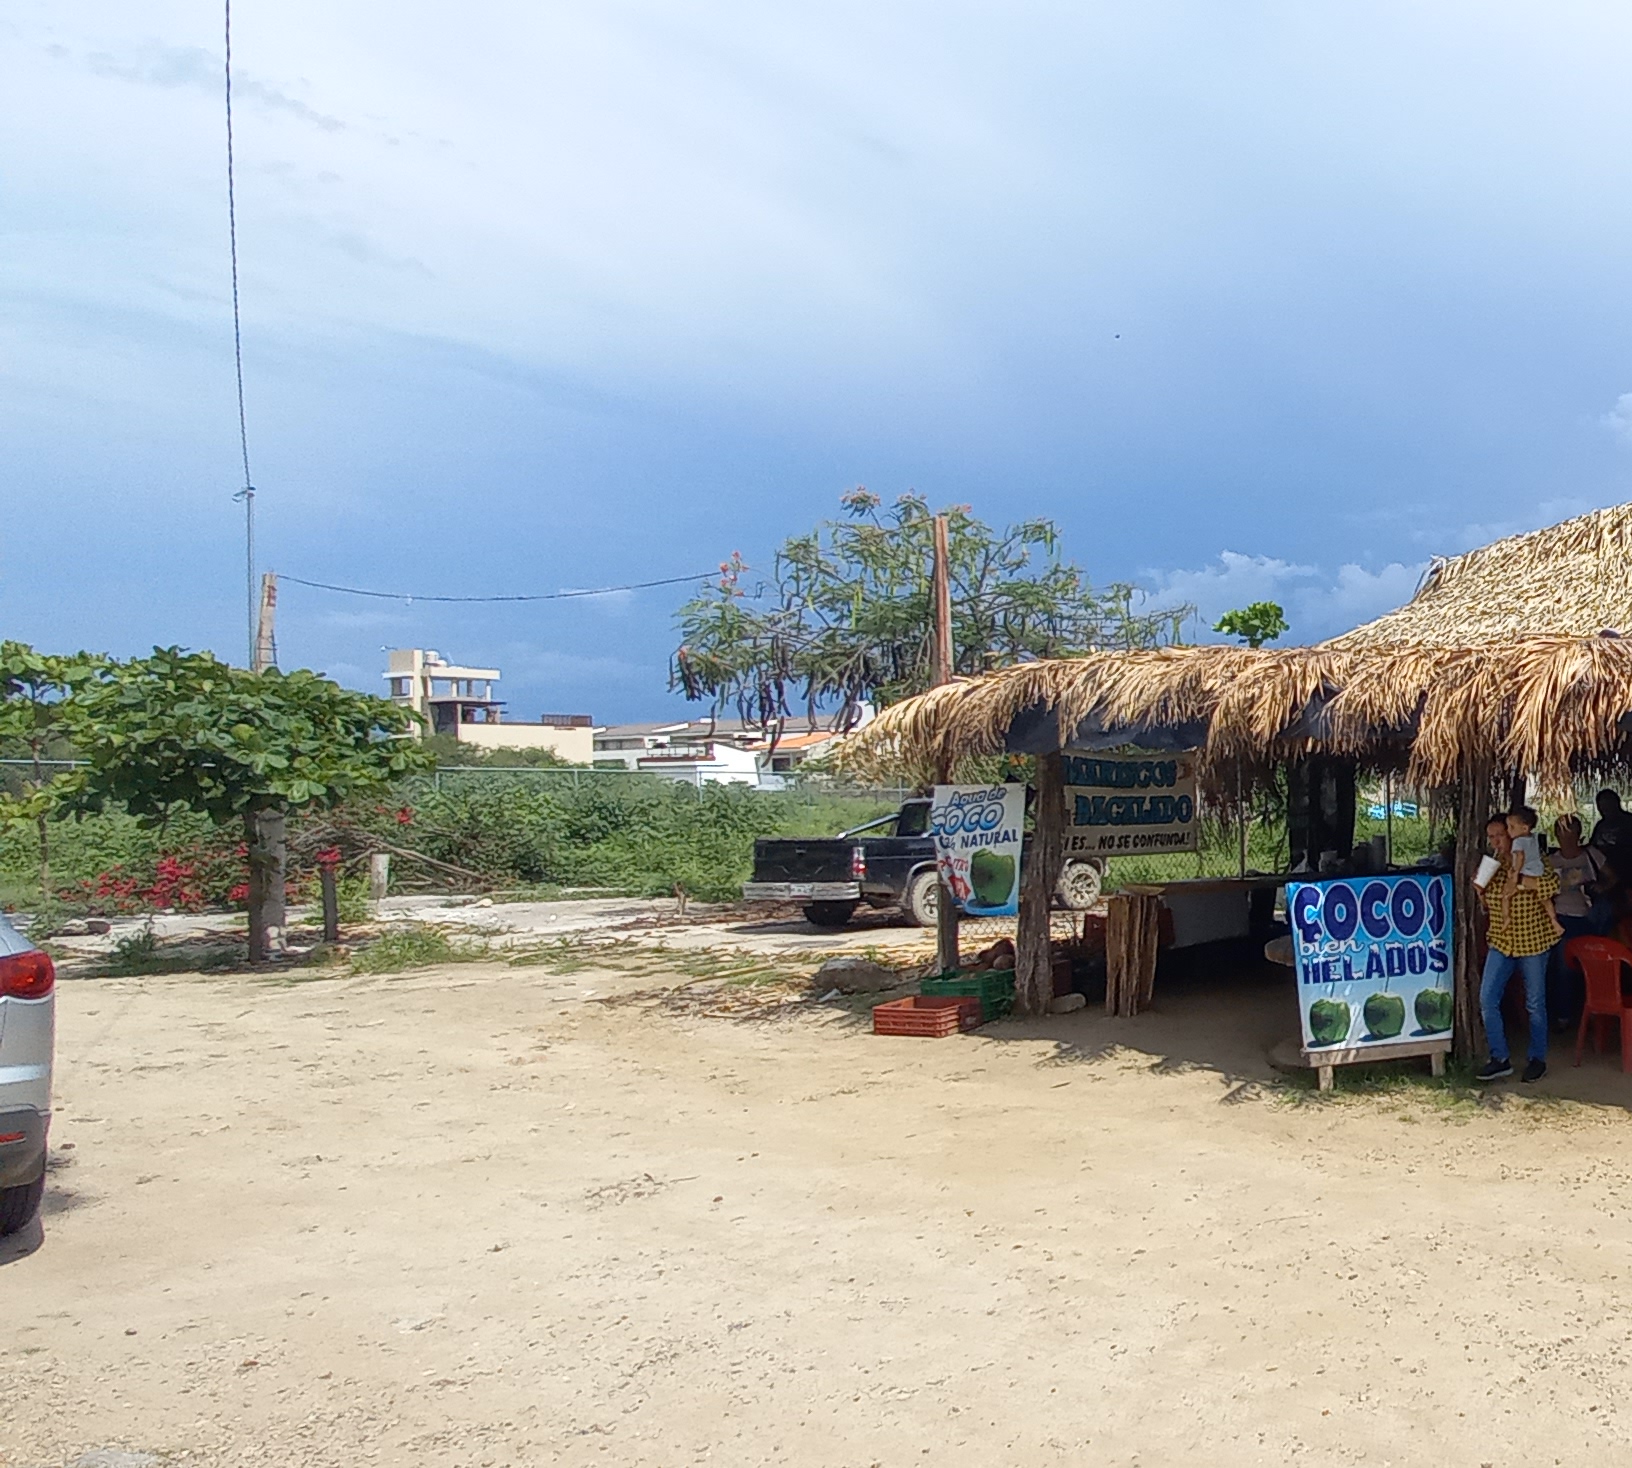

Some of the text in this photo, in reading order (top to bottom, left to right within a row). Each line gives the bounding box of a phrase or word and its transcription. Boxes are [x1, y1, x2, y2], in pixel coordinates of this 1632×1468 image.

[948, 787, 1007, 807] Agua de
[961, 829, 1018, 848] NATURAL
[1098, 833, 1115, 850] NO
[1116, 832, 1132, 849] SE
[1291, 876, 1447, 943] COCOS
[1299, 929, 1365, 959] bien
[1302, 939, 1449, 985] HELADOS
